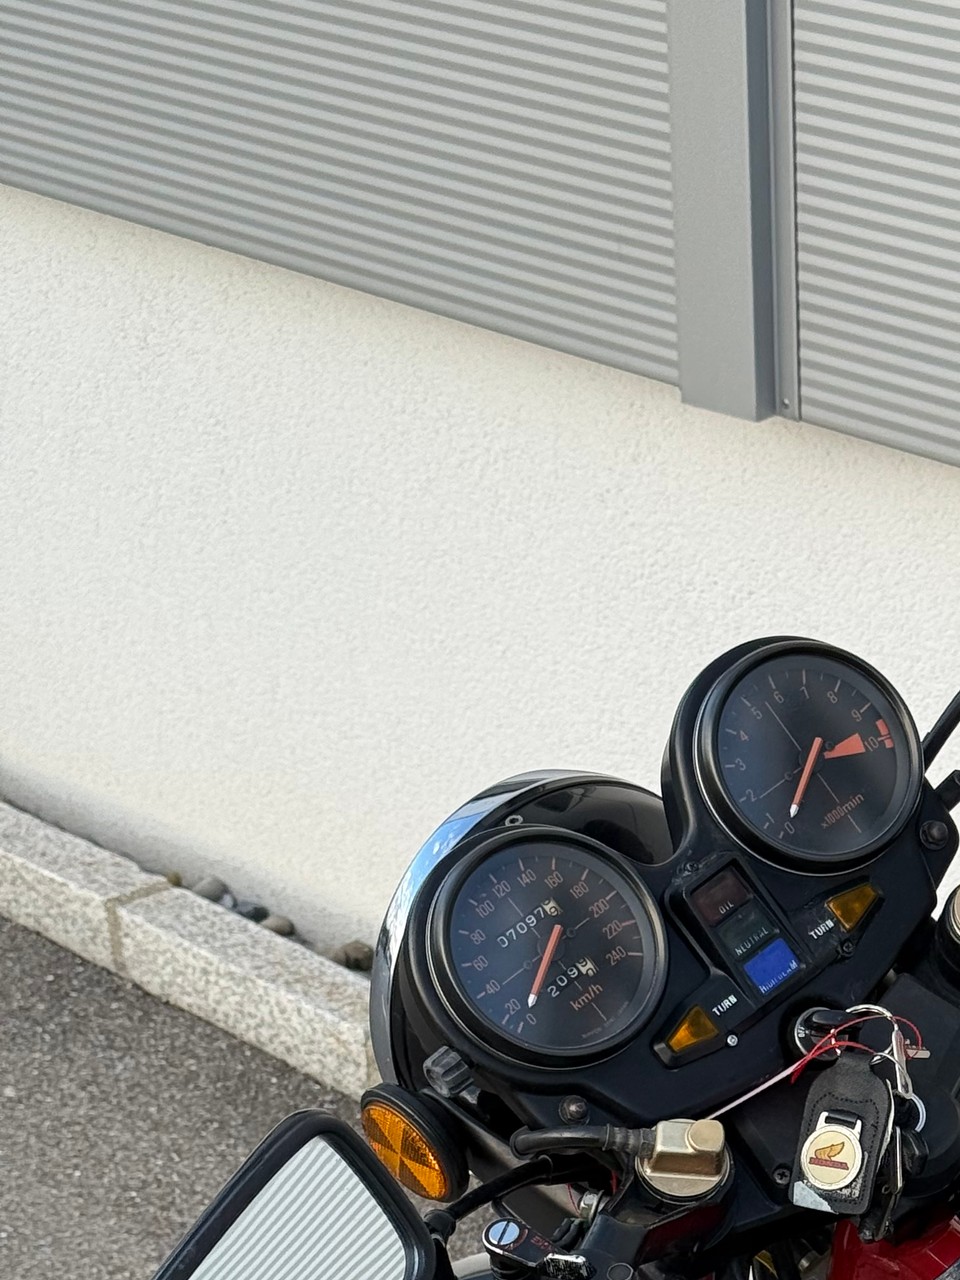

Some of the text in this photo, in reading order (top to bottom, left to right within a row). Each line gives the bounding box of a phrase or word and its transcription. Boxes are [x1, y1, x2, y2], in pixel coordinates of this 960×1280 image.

[773, 690, 785, 704] 6
[799, 686, 810, 699] 7
[827, 690, 839, 704] 8
[750, 707, 763, 720] 5
[851, 707, 863, 722] 9
[738, 730, 750, 742] 4
[864, 736, 880, 752] 10
[735, 758, 747, 771] 3
[747, 789, 758, 803] 2
[783, 821, 796, 835] 0
[517, 868, 537, 888] 140
[544, 871, 564, 889] 160
[491, 880, 511, 899] 120
[569, 881, 590, 900] 180
[475, 900, 495, 919] 100
[588, 898, 611, 919] 200
[718, 900, 734, 915] OIL
[469, 929, 487, 945] 80
[602, 920, 623, 940] 220
[808, 918, 835, 940] TURN
[734, 926, 769, 956] NEUTRAL
[472, 955, 489, 972] 60
[605, 946, 627, 967] 240
[484, 979, 501, 995] 40
[570, 984, 603, 1011] km/h
[712, 994, 738, 1017] TURN
[504, 998, 522, 1016] 20
[525, 1013, 537, 1026] 0
